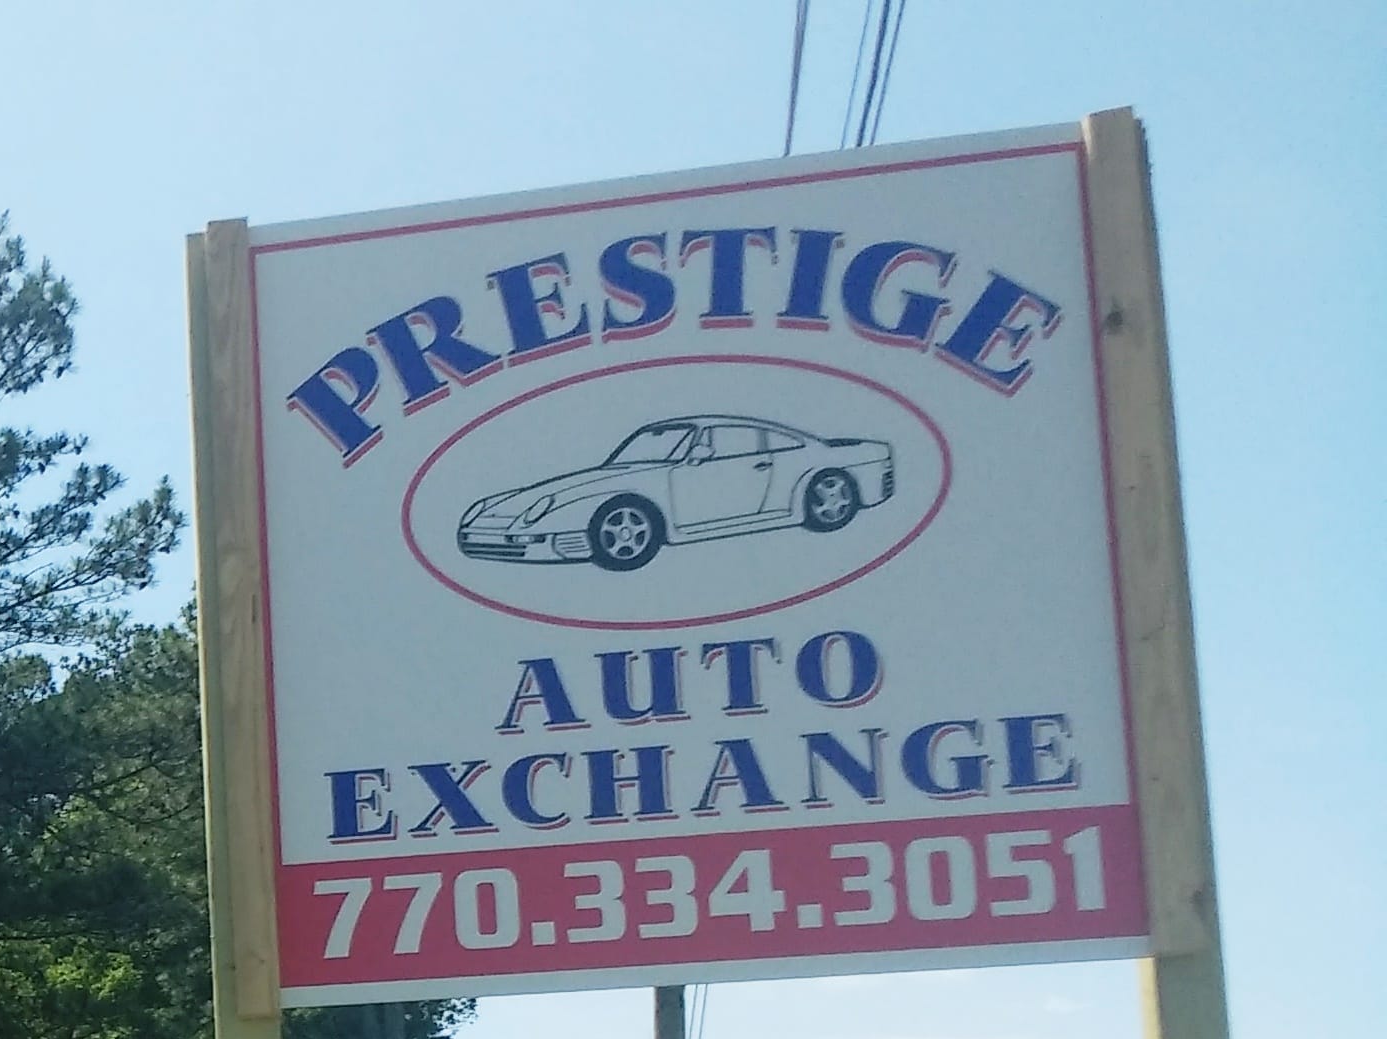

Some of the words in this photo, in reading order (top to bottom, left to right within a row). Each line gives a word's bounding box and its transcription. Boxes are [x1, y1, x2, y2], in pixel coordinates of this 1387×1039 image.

[286, 227, 1063, 467] PRESTIGE
[494, 630, 883, 734] AUTO
[325, 713, 1081, 843] EXCHANGE
[313, 825, 1107, 960] 770.334.3051
